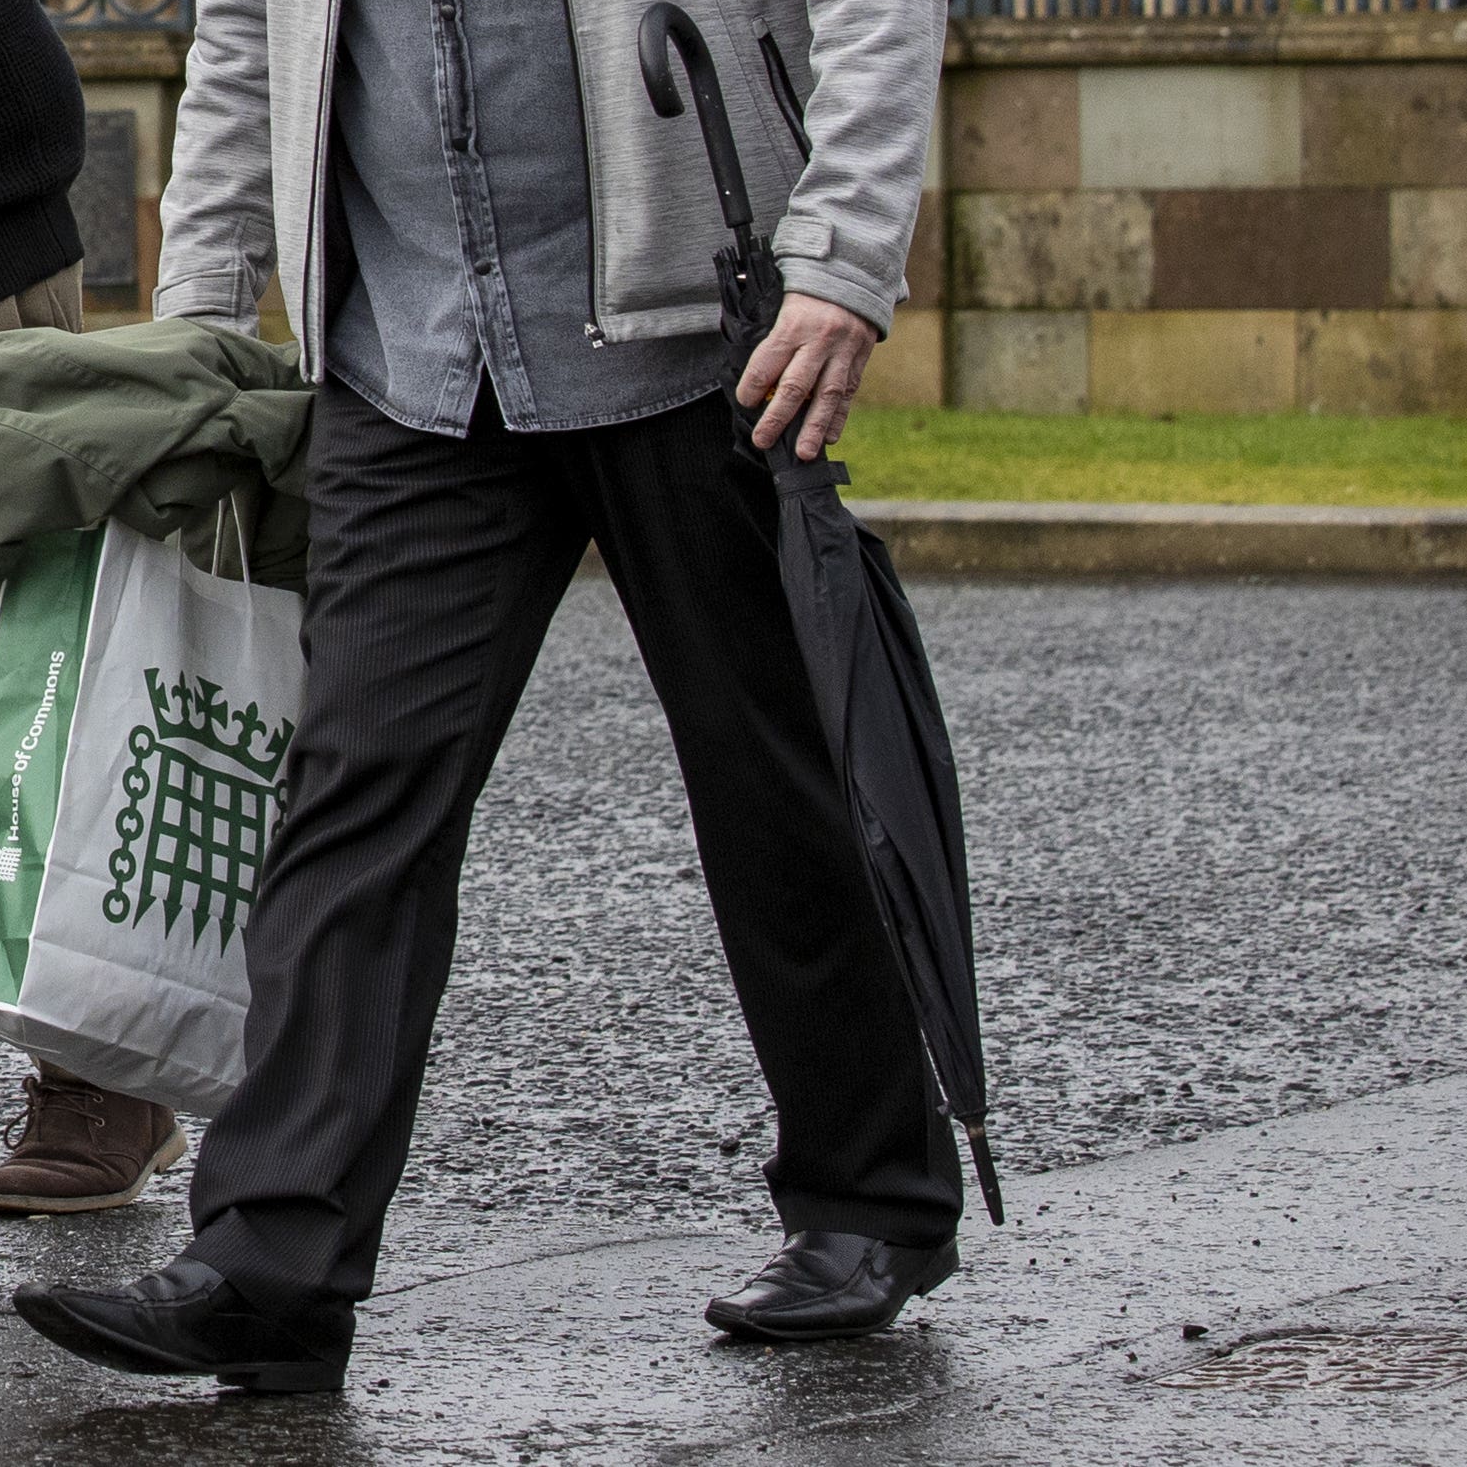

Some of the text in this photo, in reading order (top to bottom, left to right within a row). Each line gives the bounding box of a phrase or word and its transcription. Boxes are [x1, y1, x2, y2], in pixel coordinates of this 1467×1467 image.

[7, 650, 65, 842] House of Commons
